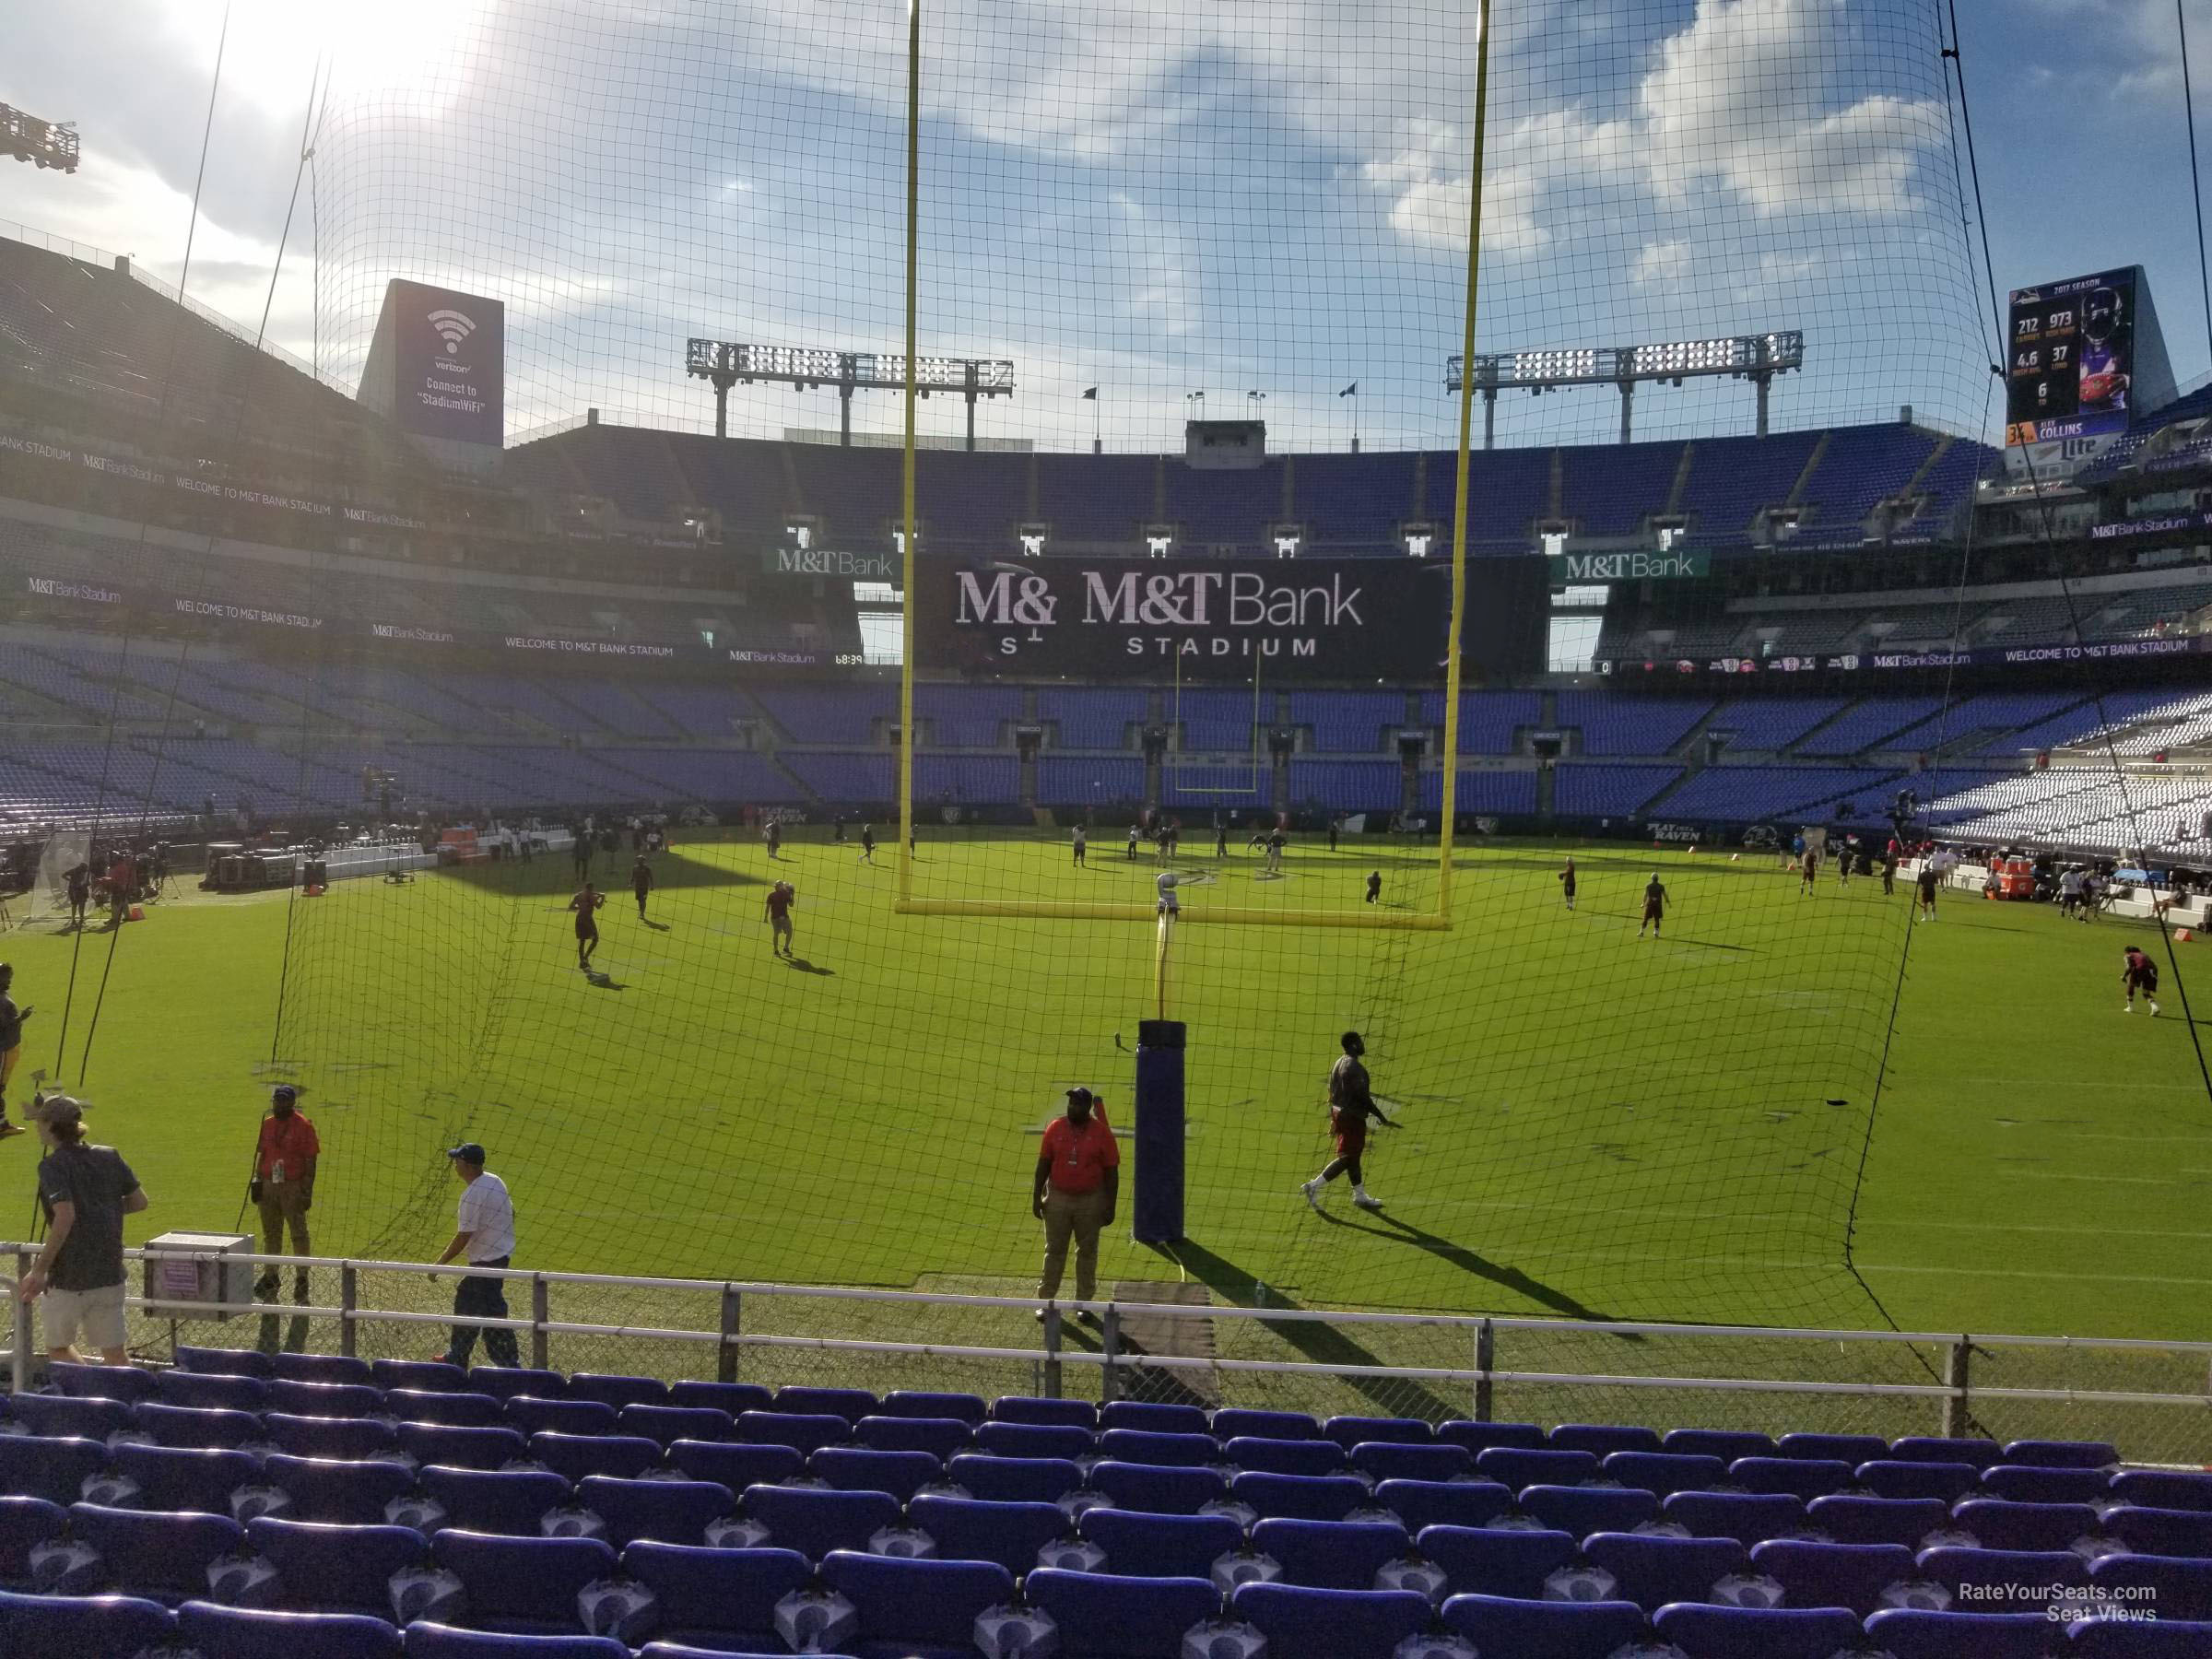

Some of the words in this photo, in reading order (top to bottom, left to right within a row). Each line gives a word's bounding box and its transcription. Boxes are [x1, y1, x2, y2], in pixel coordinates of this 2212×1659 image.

[2053, 285, 2070, 295] 2017
[2072, 278, 2100, 290] SEASON
[2018, 317, 2038, 335] 212
[2050, 311, 2072, 328] 973
[2017, 351, 2038, 367] 4.6
[2053, 346, 2067, 361] 37
[435, 361, 468, 373] verizon
[427, 377, 465, 394] Connect
[467, 385, 477, 396] to
[2038, 382, 2047, 397] 6
[2040, 423, 2082, 439] COLLINS
[26, 441, 71, 461] STADIUM
[2060, 439, 2096, 460] Lite
[83, 453, 107, 471] M&T
[177, 477, 220, 496] WELCOME
[225, 488, 236, 499] TO
[240, 490, 260, 502] M&T
[263, 495, 288, 508] BANK
[344, 508, 368, 521] M&T
[2092, 524, 2117, 538] M&T
[2118, 523, 2144, 535] Bank
[2145, 517, 2188, 532] Stadium
[776, 549, 836, 573] M&T
[839, 552, 892, 576] Bank
[1565, 553, 1630, 579] M&T
[1632, 551, 1694, 578] Bank
[29, 577, 55, 594] M&T
[56, 581, 81, 597] Bank
[81, 584, 121, 604] Stadium
[1082, 571, 1222, 625] M&T
[1230, 572, 1363, 626] Bank
[176, 599, 223, 617] WELCOME
[226, 606, 238, 618] TO
[240, 608, 260, 620] M&T
[262, 611, 285, 625] BANK
[372, 624, 394, 637] M&T
[505, 637, 556, 650] WELCOME
[559, 641, 573, 651] TO
[575, 641, 596, 653] M&T
[599, 643, 627, 655] BANK
[629, 645, 673, 657] STADIUM
[1126, 637, 1316, 656] STADIUM
[2006, 649, 2062, 661] WELCOME
[2065, 647, 2080, 658] TO
[2084, 645, 2108, 656] M&T
[2111, 643, 2138, 655] BANK
[2141, 641, 2188, 653] STADIUM
[730, 650, 753, 661] M&T
[754, 653, 777, 663] Bank
[777, 653, 815, 664] Stadium
[1874, 655, 1902, 667] M&T
[1902, 654, 1927, 666] Bank
[1654, 831, 1700, 841] RAVEN
